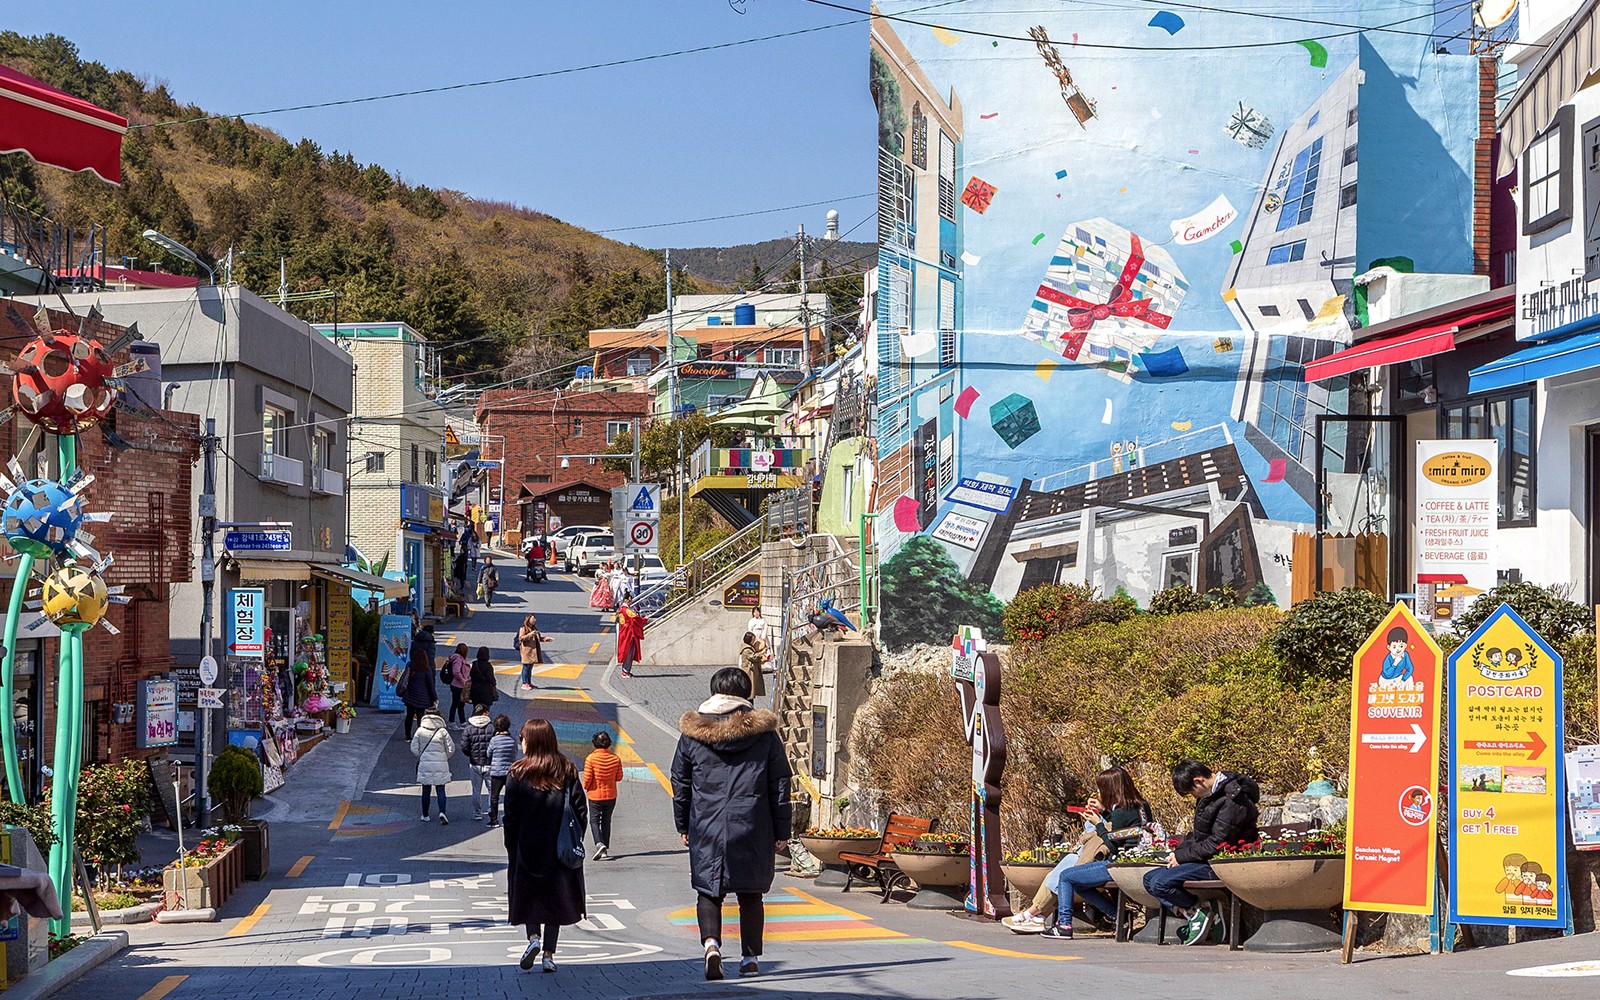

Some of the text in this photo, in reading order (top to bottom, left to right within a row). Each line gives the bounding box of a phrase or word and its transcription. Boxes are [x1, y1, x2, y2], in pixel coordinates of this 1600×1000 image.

[680, 364, 728, 376] Chocolate
[1432, 464, 1457, 476] miro
[1461, 464, 1486, 476] miro
[1425, 501, 1489, 511] COFFEE & LATTE
[636, 528, 649, 539] 30
[1424, 528, 1489, 537] FRESH FRUIT JUICE
[1425, 538, 1463, 546] (생과일주스)
[1424, 551, 1488, 561] BEVERAGE (음료)
[236, 592, 255, 641] 체험장
[1368, 681, 1424, 693] 감천문화마을
[1468, 685, 1543, 698] POSTCARD
[1397, 693, 1424, 704] 도자기
[1368, 706, 1422, 718] SOUVENIR
[1463, 807, 1495, 819] BUY 4
[1462, 821, 1518, 835] GET 1 FREE
[1382, 846, 1401, 856] Village
[1354, 853, 1401, 864] Ceramic Magnet
